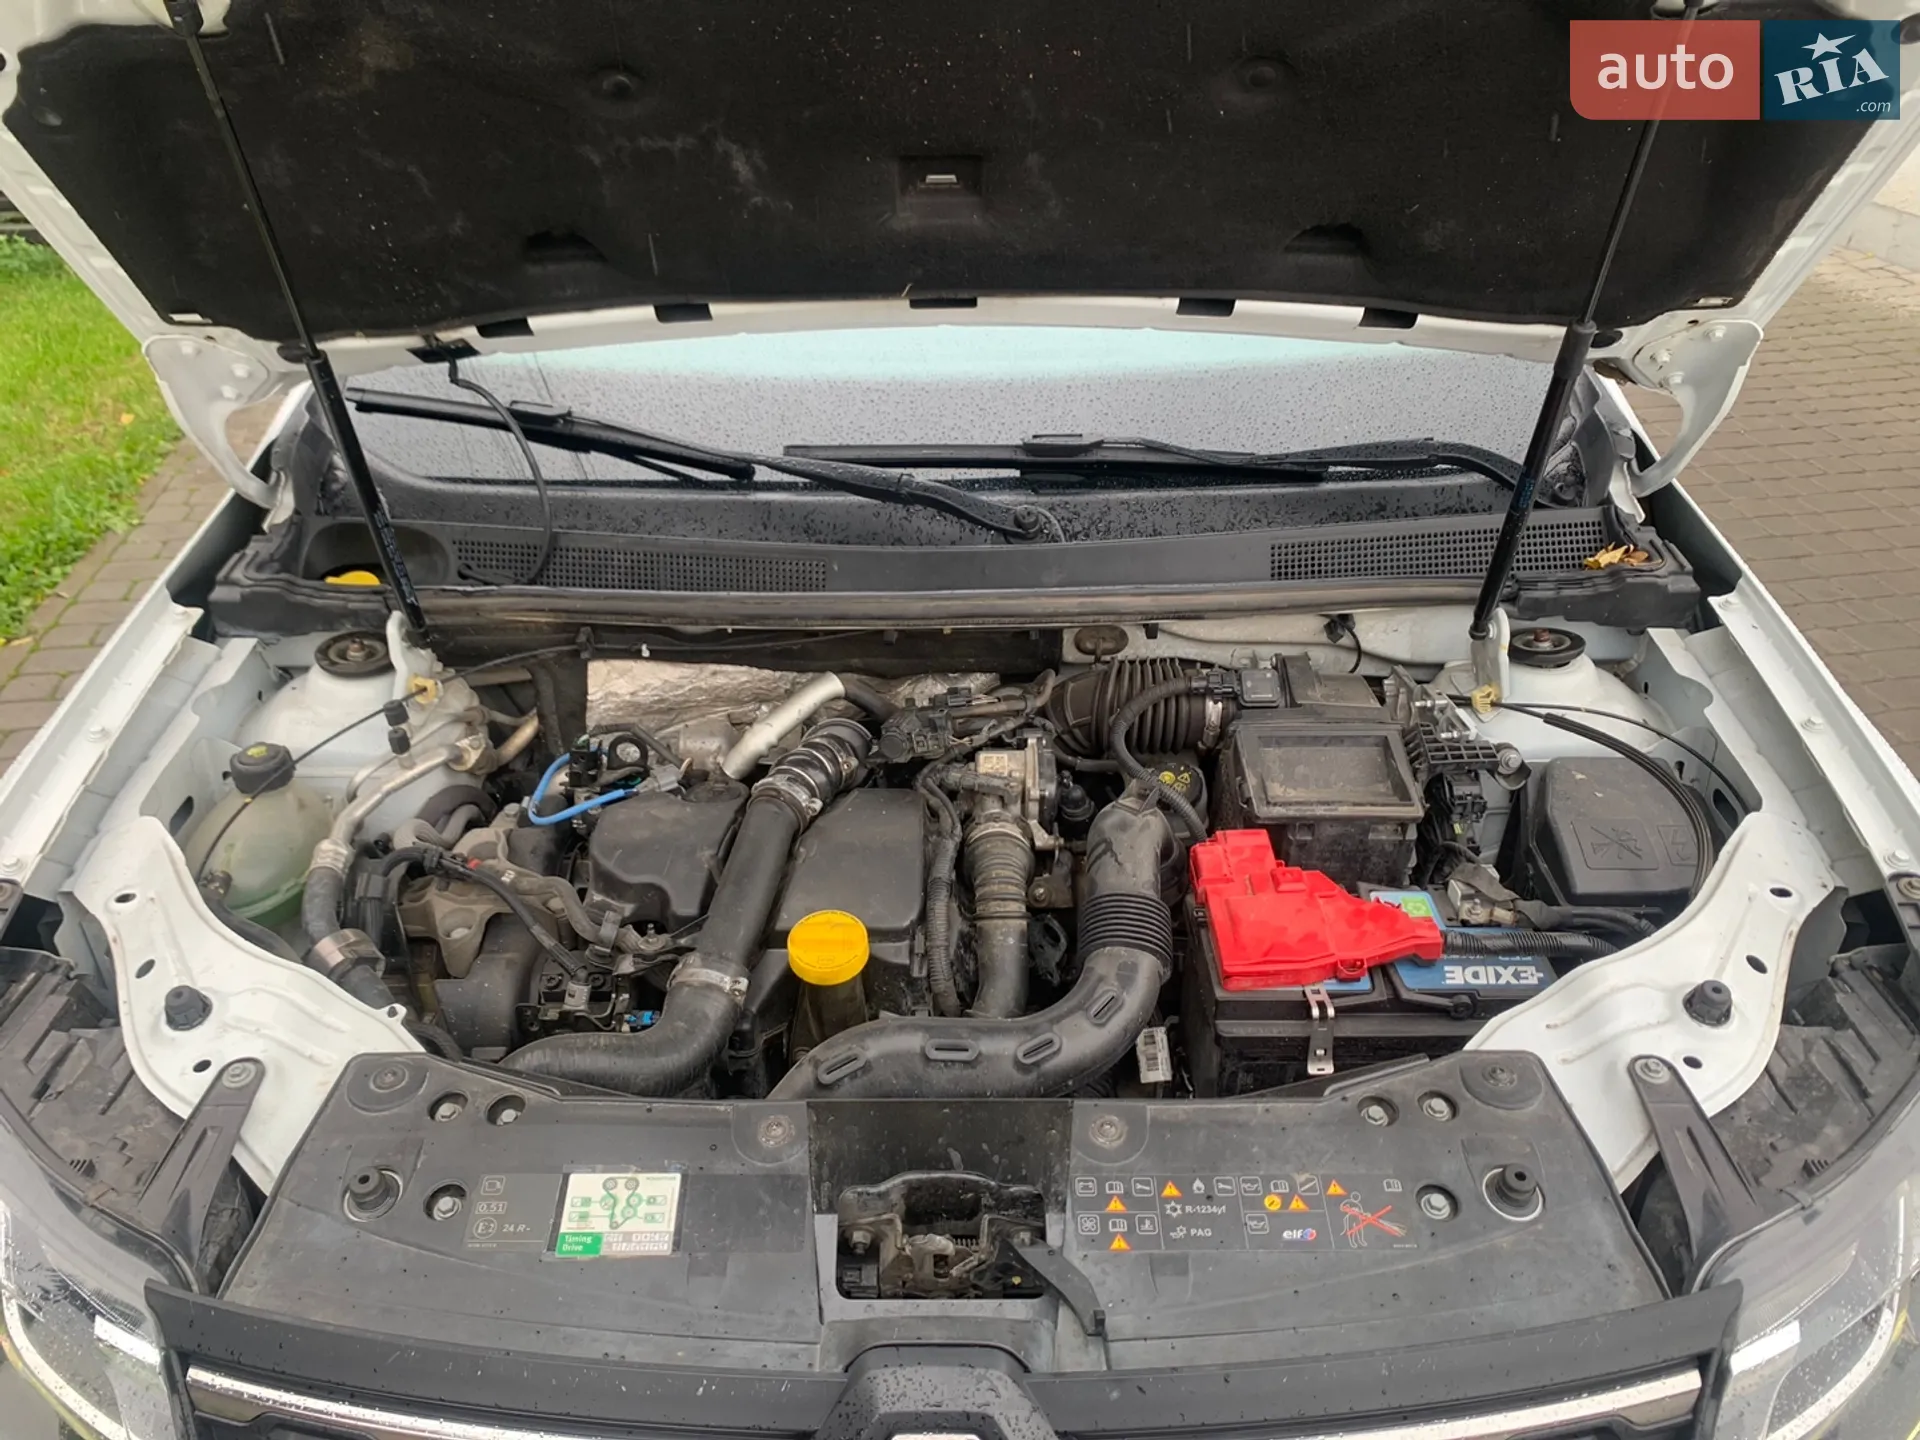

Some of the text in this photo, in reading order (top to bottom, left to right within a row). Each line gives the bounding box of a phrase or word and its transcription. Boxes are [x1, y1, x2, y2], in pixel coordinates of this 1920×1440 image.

[1444, 965, 1539, 985] EXIDE
[1190, 1227, 1213, 1238] PAG
[1282, 1229, 1304, 1239] elf
[564, 1234, 592, 1244] Timing
[562, 1243, 584, 1252] Drive
